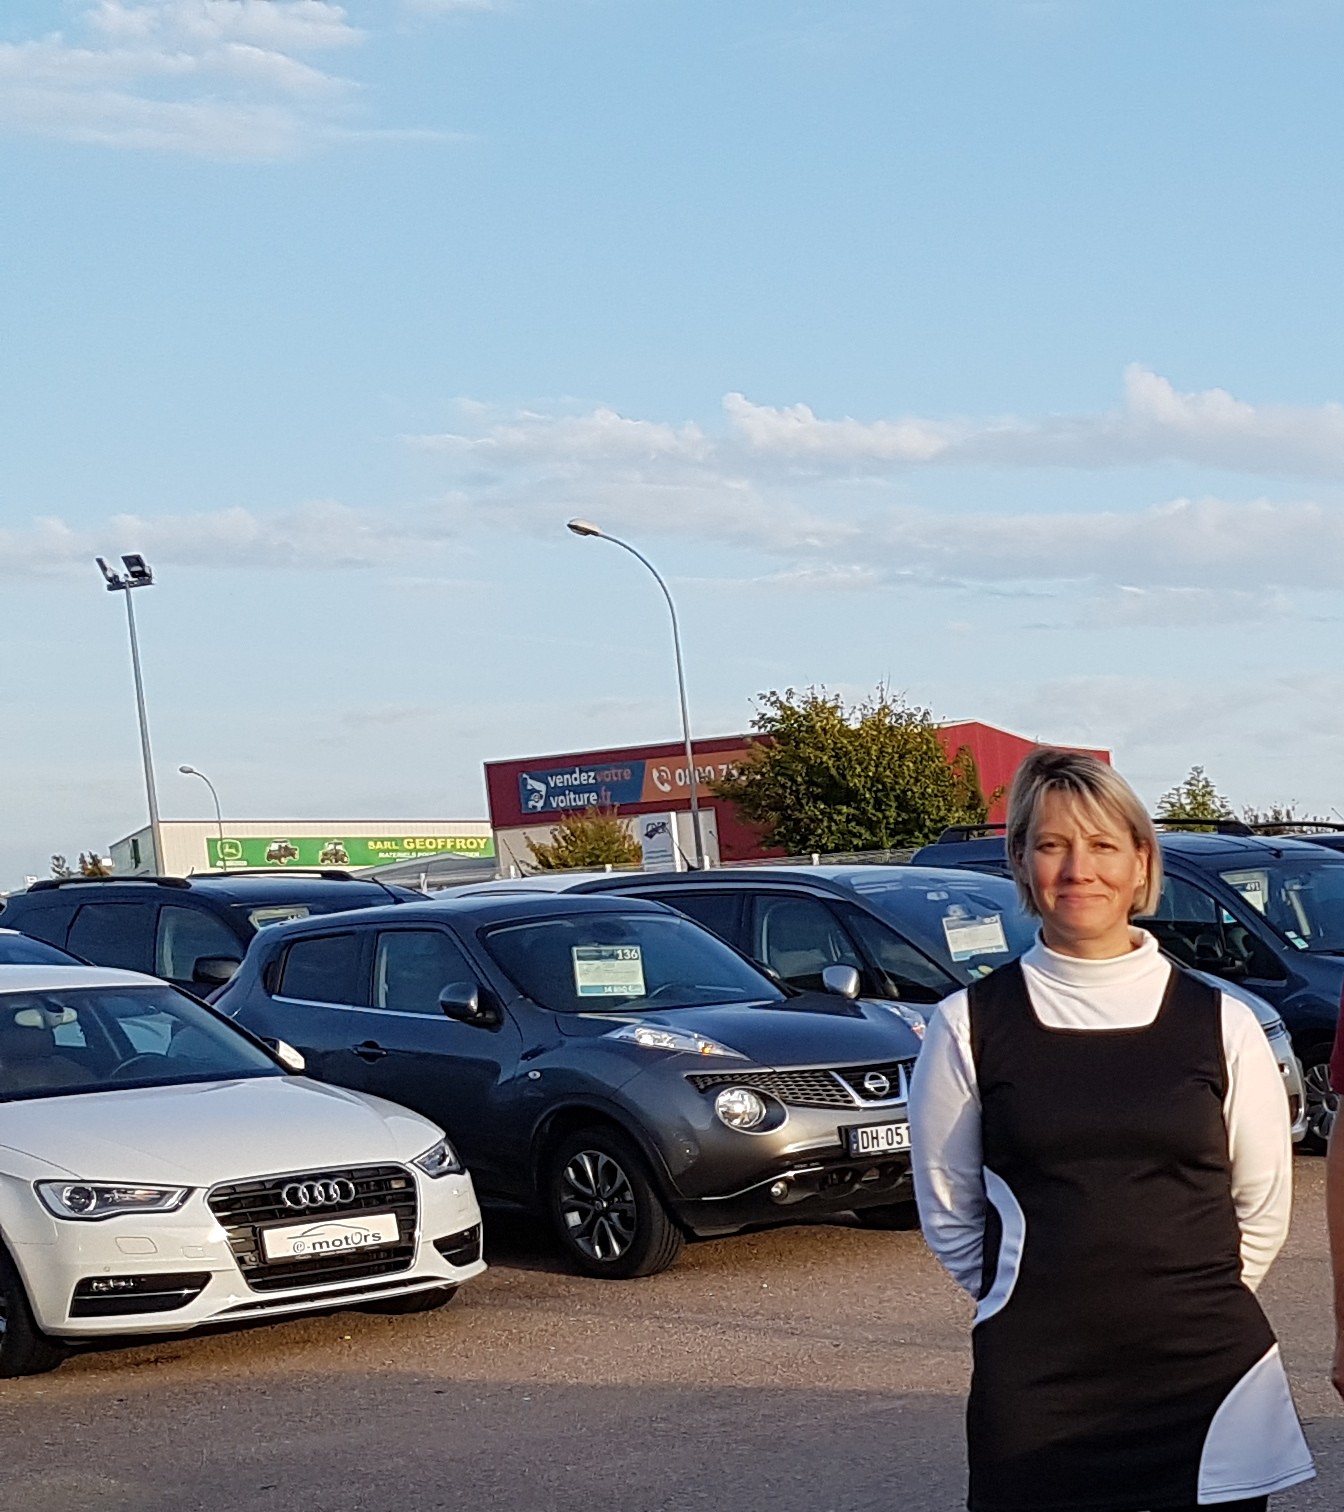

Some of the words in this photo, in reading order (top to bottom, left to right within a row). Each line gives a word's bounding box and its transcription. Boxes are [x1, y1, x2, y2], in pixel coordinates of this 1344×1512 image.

[368, 841, 399, 850] SARL
[403, 838, 488, 850] GEOFFROY
[616, 949, 638, 960] 136
